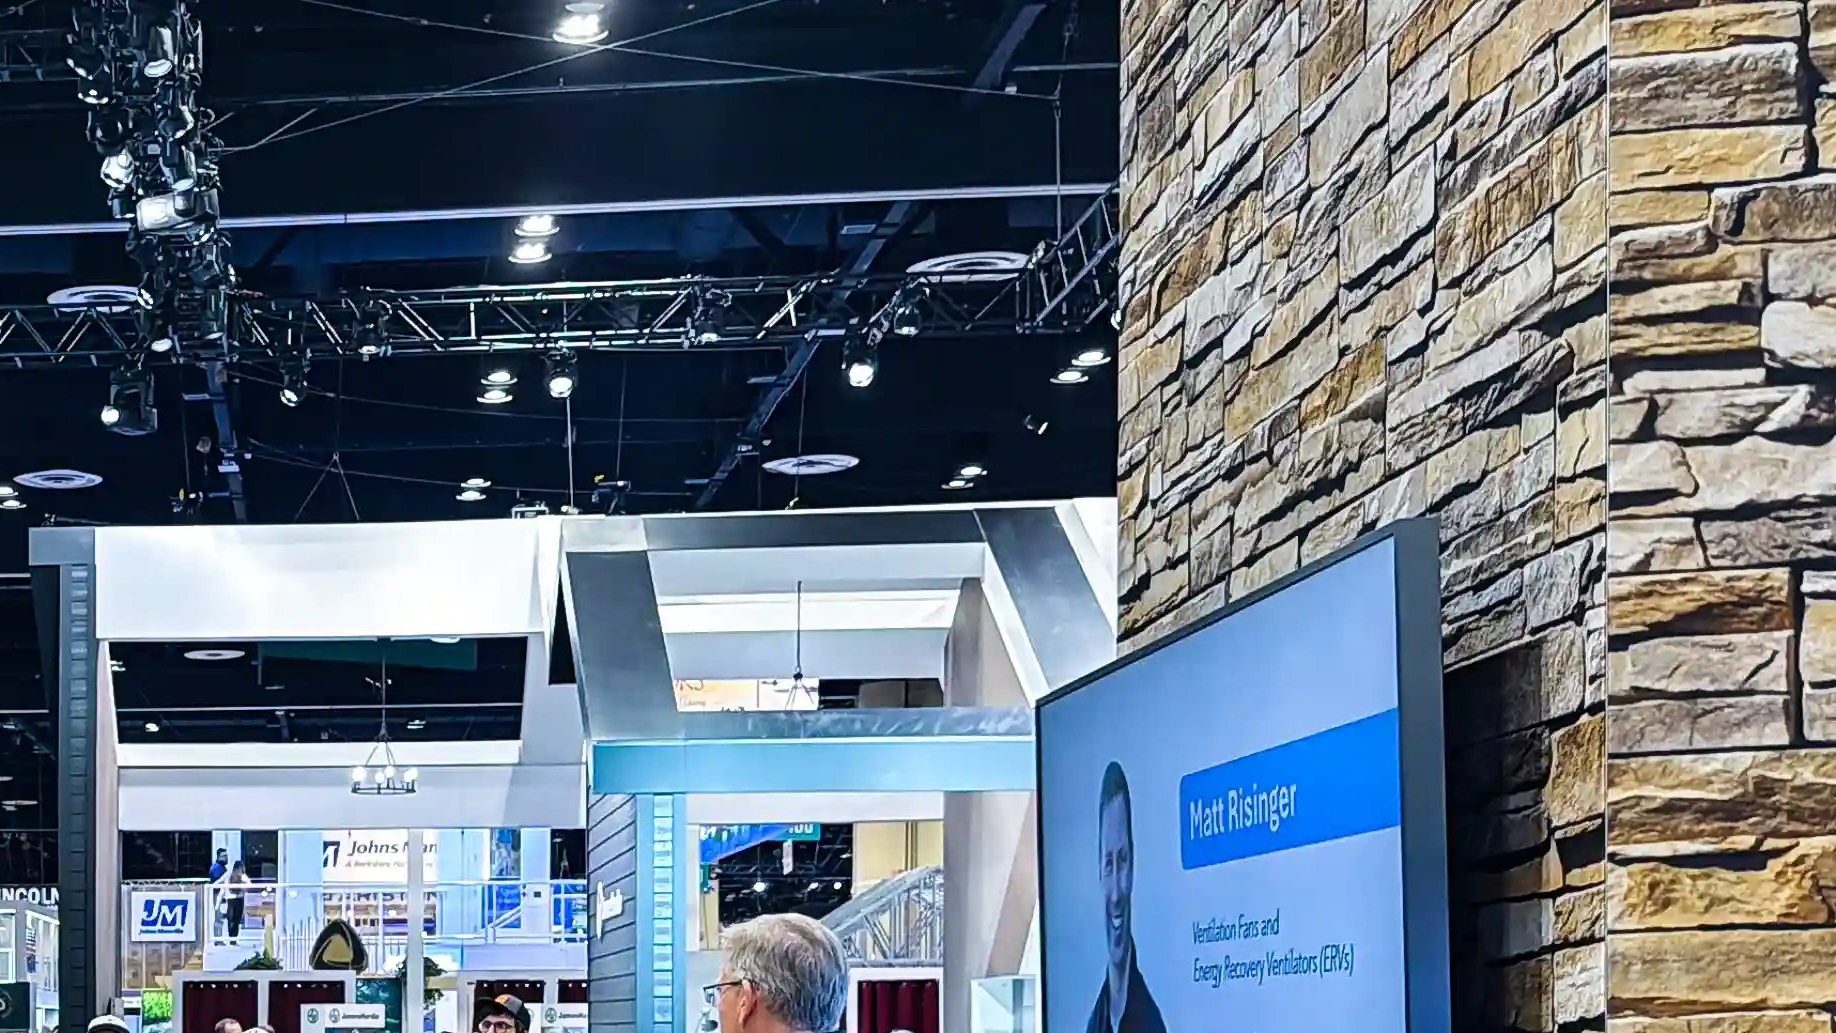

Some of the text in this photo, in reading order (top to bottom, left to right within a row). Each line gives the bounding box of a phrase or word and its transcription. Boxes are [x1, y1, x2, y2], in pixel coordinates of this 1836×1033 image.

[1190, 782, 1297, 840] Matt Risinger
[347, 840, 399, 857] Johns
[1192, 907, 1280, 945] Ventilation Fans and
[1193, 943, 1355, 988] Energy Recovery Ventilators (ERVs)
